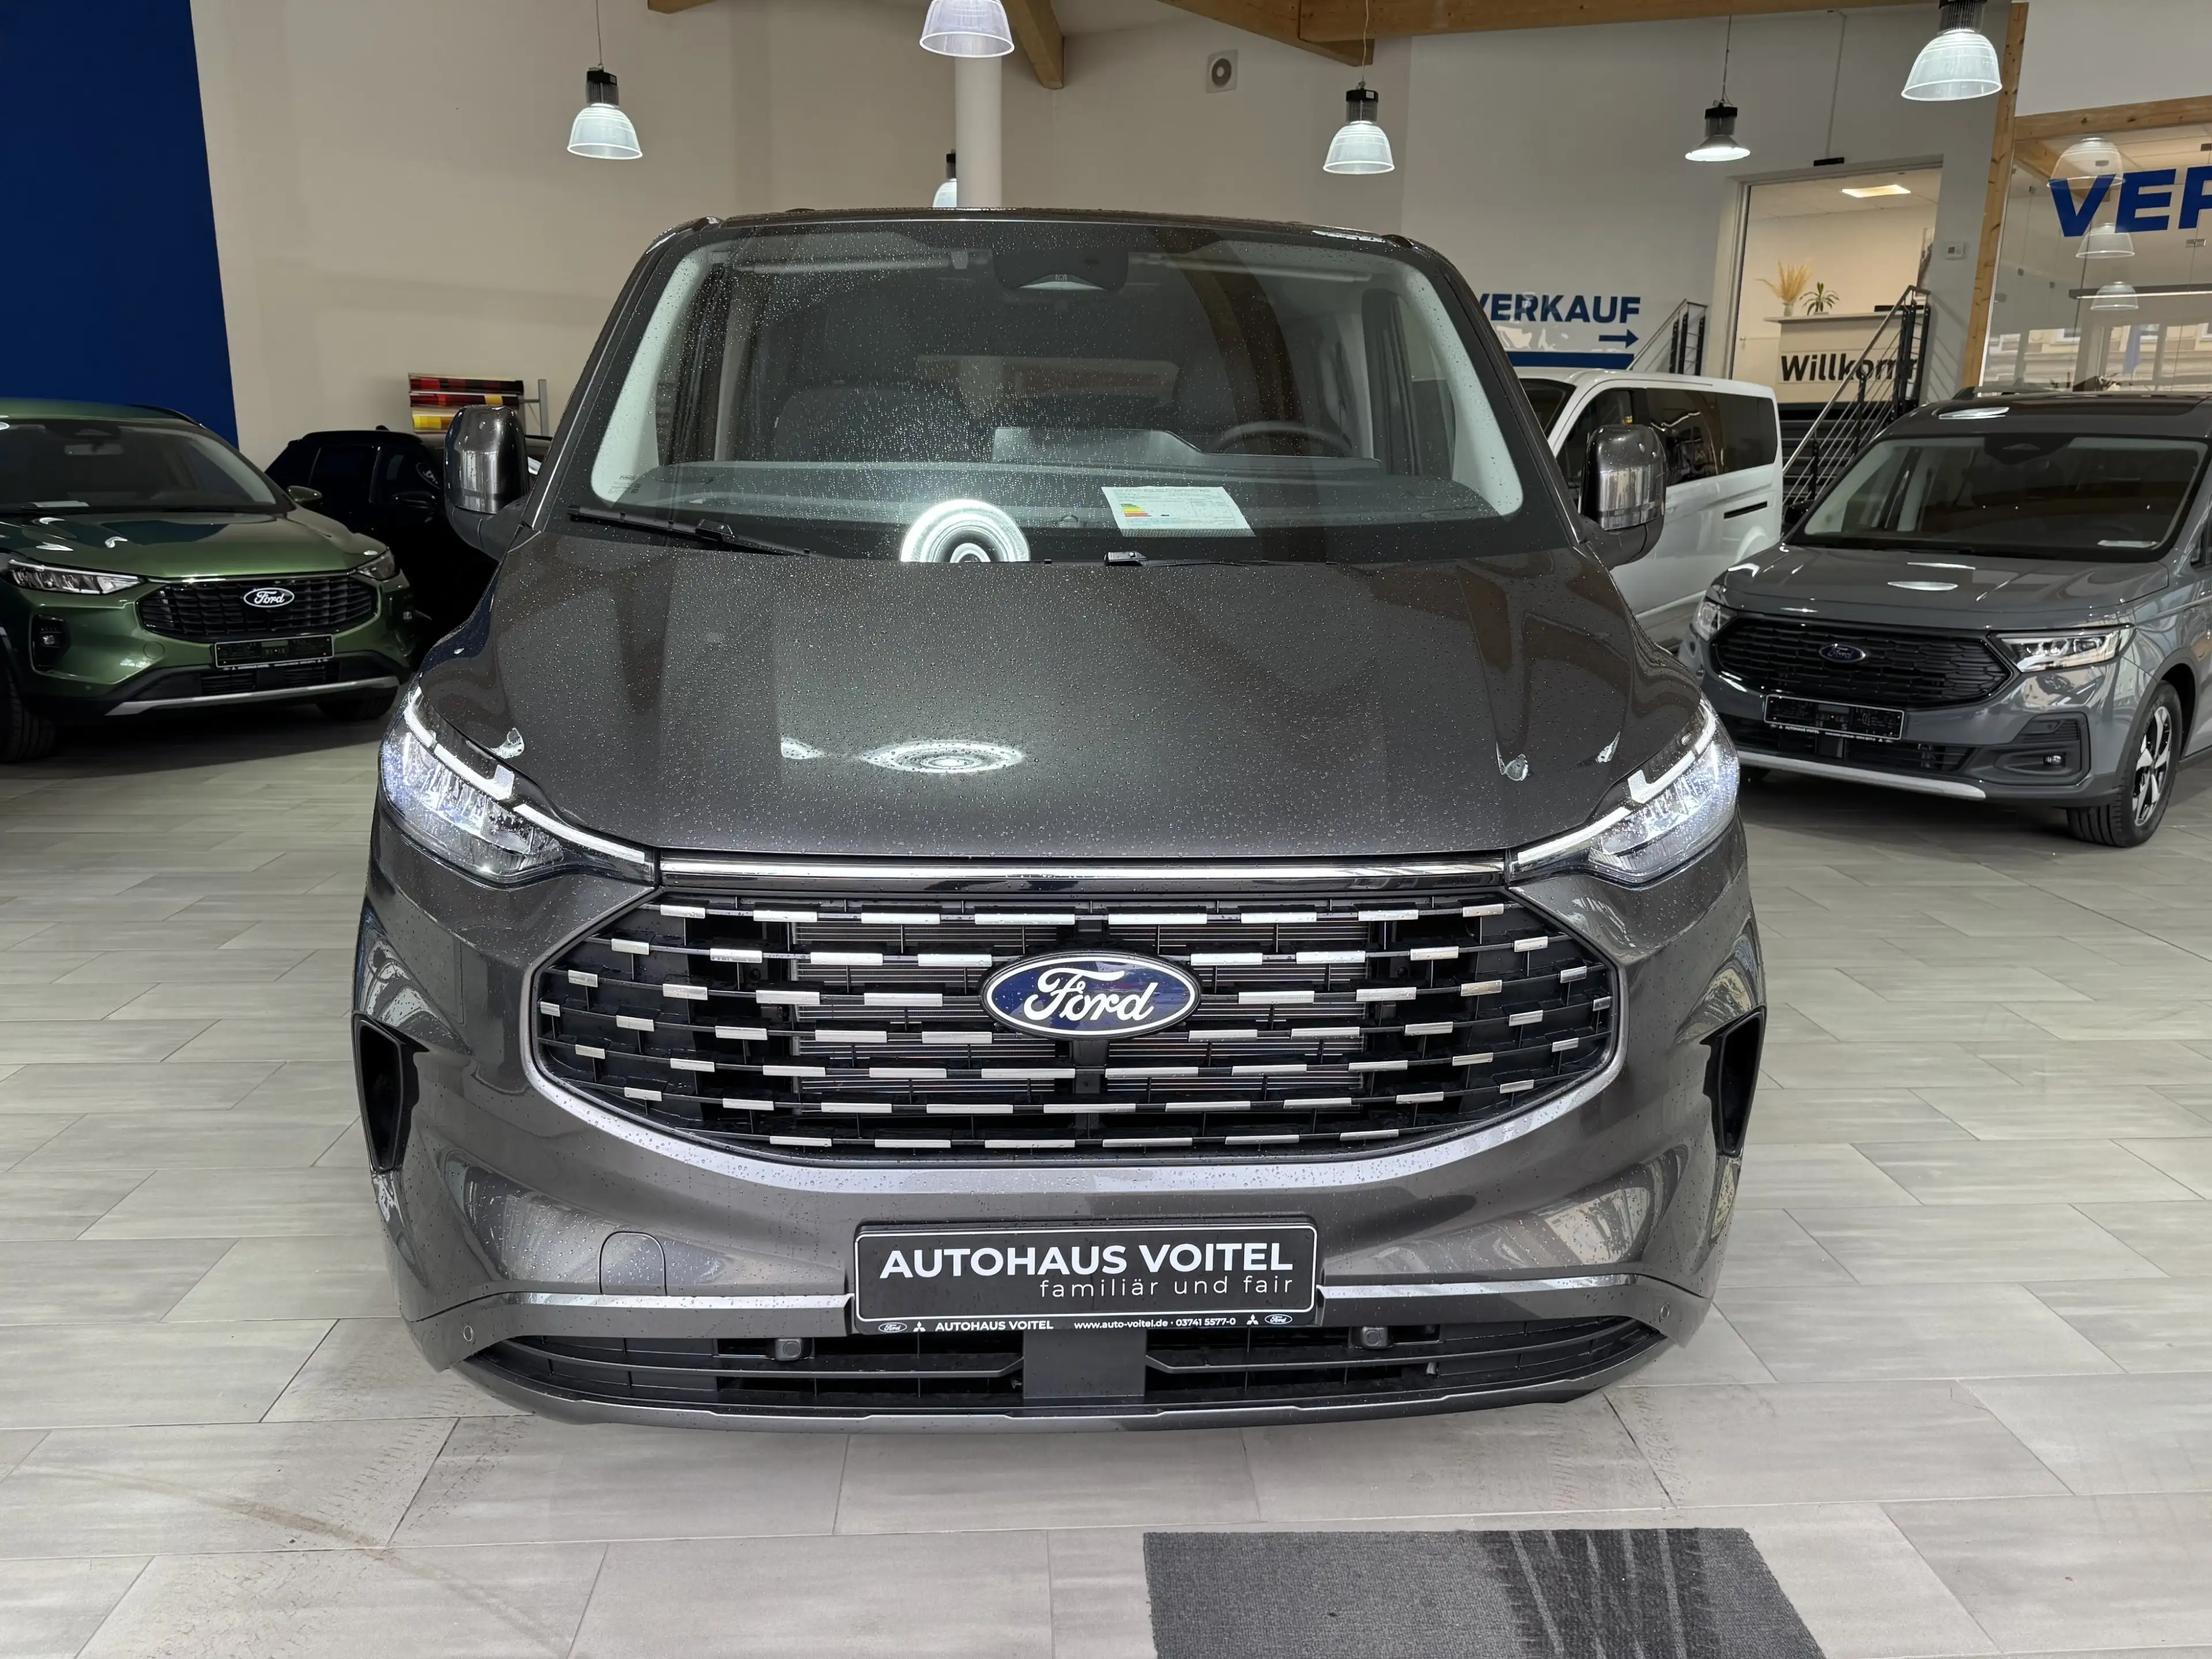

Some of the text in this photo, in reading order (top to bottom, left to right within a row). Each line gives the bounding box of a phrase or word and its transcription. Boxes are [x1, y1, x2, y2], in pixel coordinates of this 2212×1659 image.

[254, 591, 285, 604] Ford
[1024, 968, 1158, 1021] Ford
[879, 1243, 1293, 1279] AUTOHAUS VOITEL
[1039, 1275, 1293, 1297] familiär und fair
[935, 1317, 1236, 1332] AUTOHAUS VOITEL www.auto-voitel.de 03741 5577-0
